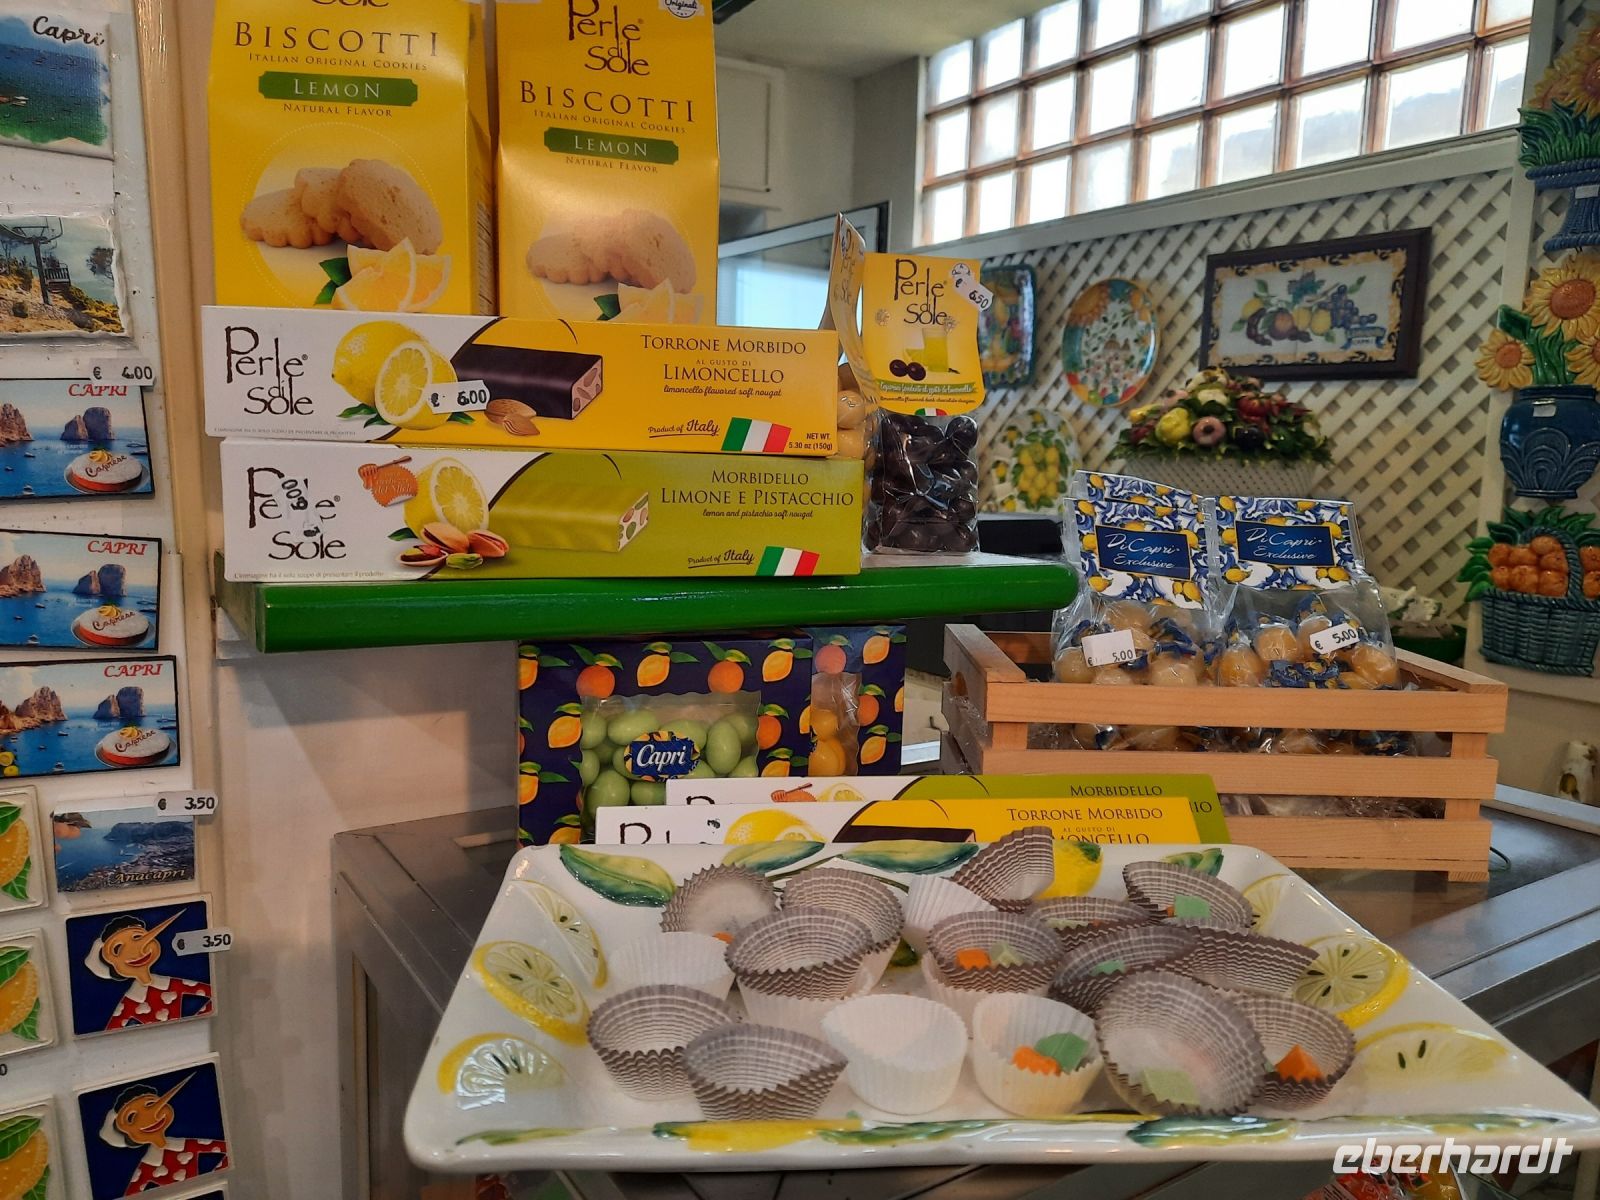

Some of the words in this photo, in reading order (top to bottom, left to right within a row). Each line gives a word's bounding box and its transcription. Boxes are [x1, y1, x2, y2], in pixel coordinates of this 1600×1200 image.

[33, 16, 105, 46] Capri
[235, 21, 439, 57] BISCOTTI
[249, 53, 299, 64] ITALIAN
[305, 56, 367, 67] ORIGINAL
[373, 60, 428, 71] COOKIES
[293, 79, 381, 98] LEMON
[520, 80, 695, 122] BISCOTTI
[283, 104, 339, 115] NATURAL
[346, 106, 393, 117] FLAVOR
[533, 109, 578, 121] ITALIAN
[583, 115, 636, 128] ORIGINAL
[640, 121, 686, 133] COOKIES
[574, 135, 648, 156] LEMON
[565, 156, 613, 169] NATURAL
[619, 161, 659, 173] FLAVOR
[893, 259, 945, 301] Perle
[640, 334, 720, 352] TORRONE
[726, 339, 806, 355] MORBIDO
[225, 326, 305, 384] Perle
[710, 359, 738, 367] GUSTO
[93, 366, 102, 380] €
[663, 364, 784, 383] LIMONCELLO
[68, 383, 128, 397] CAPRI
[663, 385, 704, 394] limoncello
[703, 386, 737, 396] flavored
[738, 387, 754, 398] soft
[755, 389, 782, 398] nougat
[648, 425, 675, 433] Product
[676, 424, 684, 433] of
[686, 419, 720, 437] Italy
[789, 441, 803, 449] 5.30
[813, 442, 833, 450] (150g)
[711, 470, 809, 485] MORBIDELLO
[661, 488, 731, 504] LIMONE
[738, 491, 746, 504] E
[754, 490, 854, 506] PISTACCHIO
[702, 509, 725, 517] lemon
[726, 509, 739, 517] and
[741, 509, 773, 519] pistachio
[774, 510, 788, 520] soft
[789, 510, 813, 520] nougat
[87, 540, 148, 555] CAPRI
[1253, 545, 1316, 560] Exclusive
[688, 555, 712, 564] Product
[714, 554, 721, 564] of
[723, 549, 755, 566] Italy
[1113, 552, 1175, 569] Exclusive
[1315, 640, 1324, 650] €
[104, 664, 162, 678] CAPRI
[636, 743, 687, 771] Capri
[1070, 785, 1163, 797] MORBIDELLO
[1007, 808, 1082, 821] TORRONE
[1088, 808, 1163, 820] MORBIDO
[115, 869, 185, 883] Anacapri
